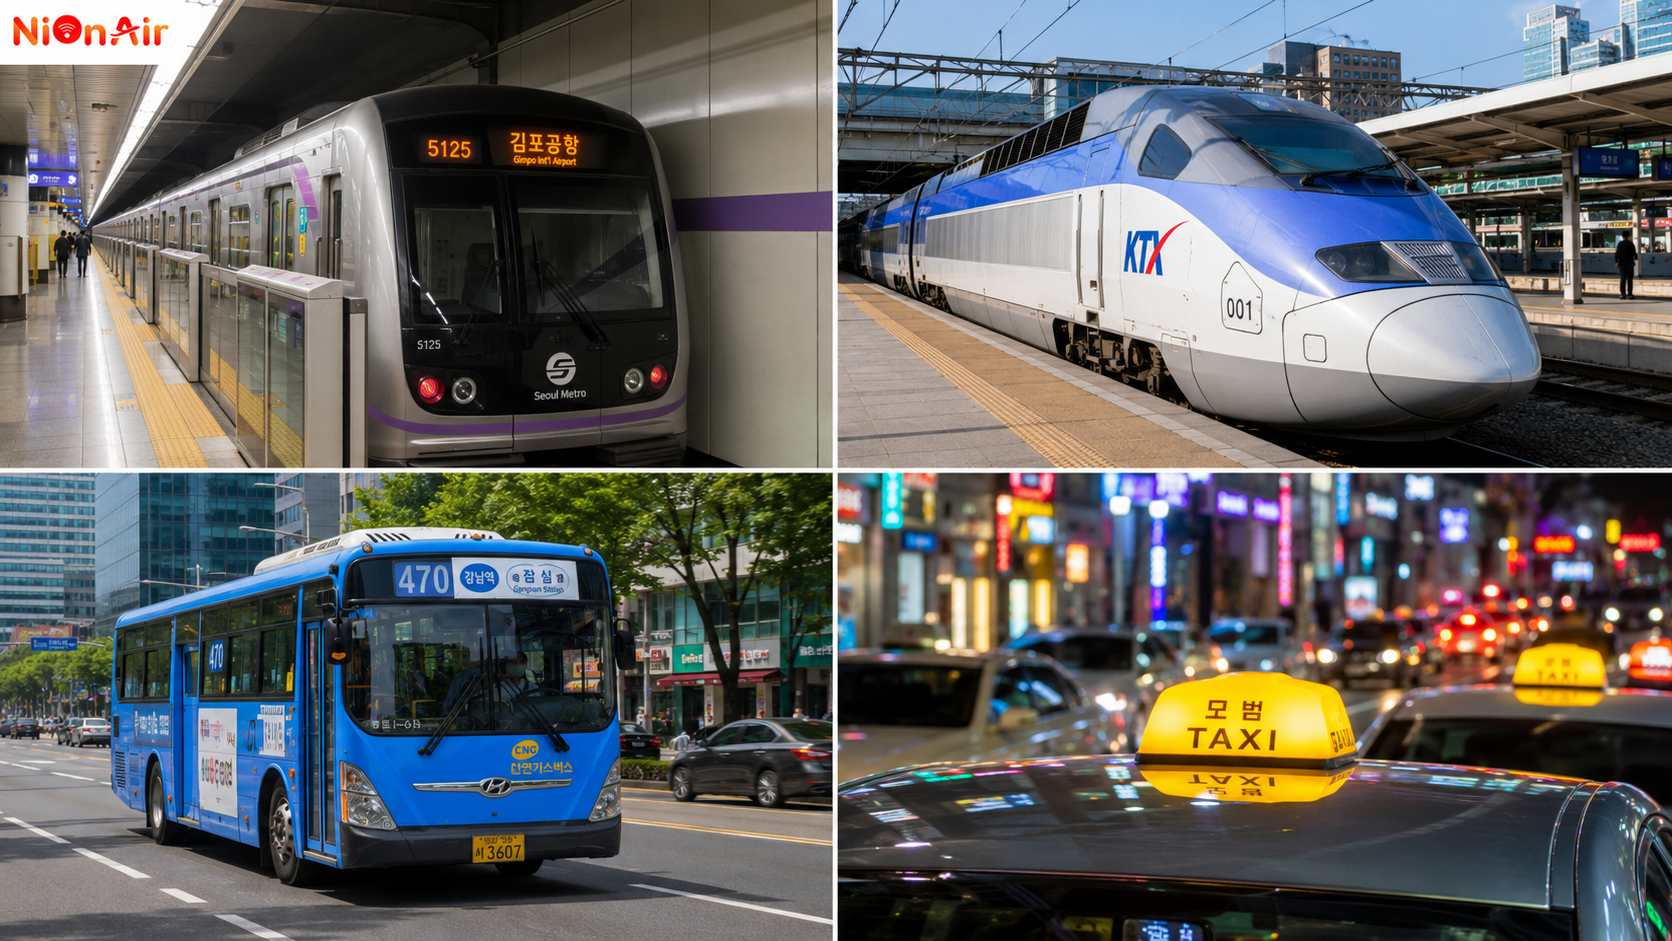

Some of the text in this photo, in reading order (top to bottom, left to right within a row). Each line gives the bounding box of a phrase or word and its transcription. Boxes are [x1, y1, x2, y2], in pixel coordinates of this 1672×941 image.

[427, 139, 471, 159] 5125
[510, 132, 579, 155] 김포공항
[513, 155, 537, 166] Gimpo
[1123, 221, 1185, 276] KTX
[1226, 297, 1252, 321] 001
[534, 389, 587, 401] Seoul Metro
[398, 564, 449, 594] 470
[209, 643, 224, 671] 470
[1187, 727, 1277, 751] TAXI
[487, 844, 521, 860] 3607
